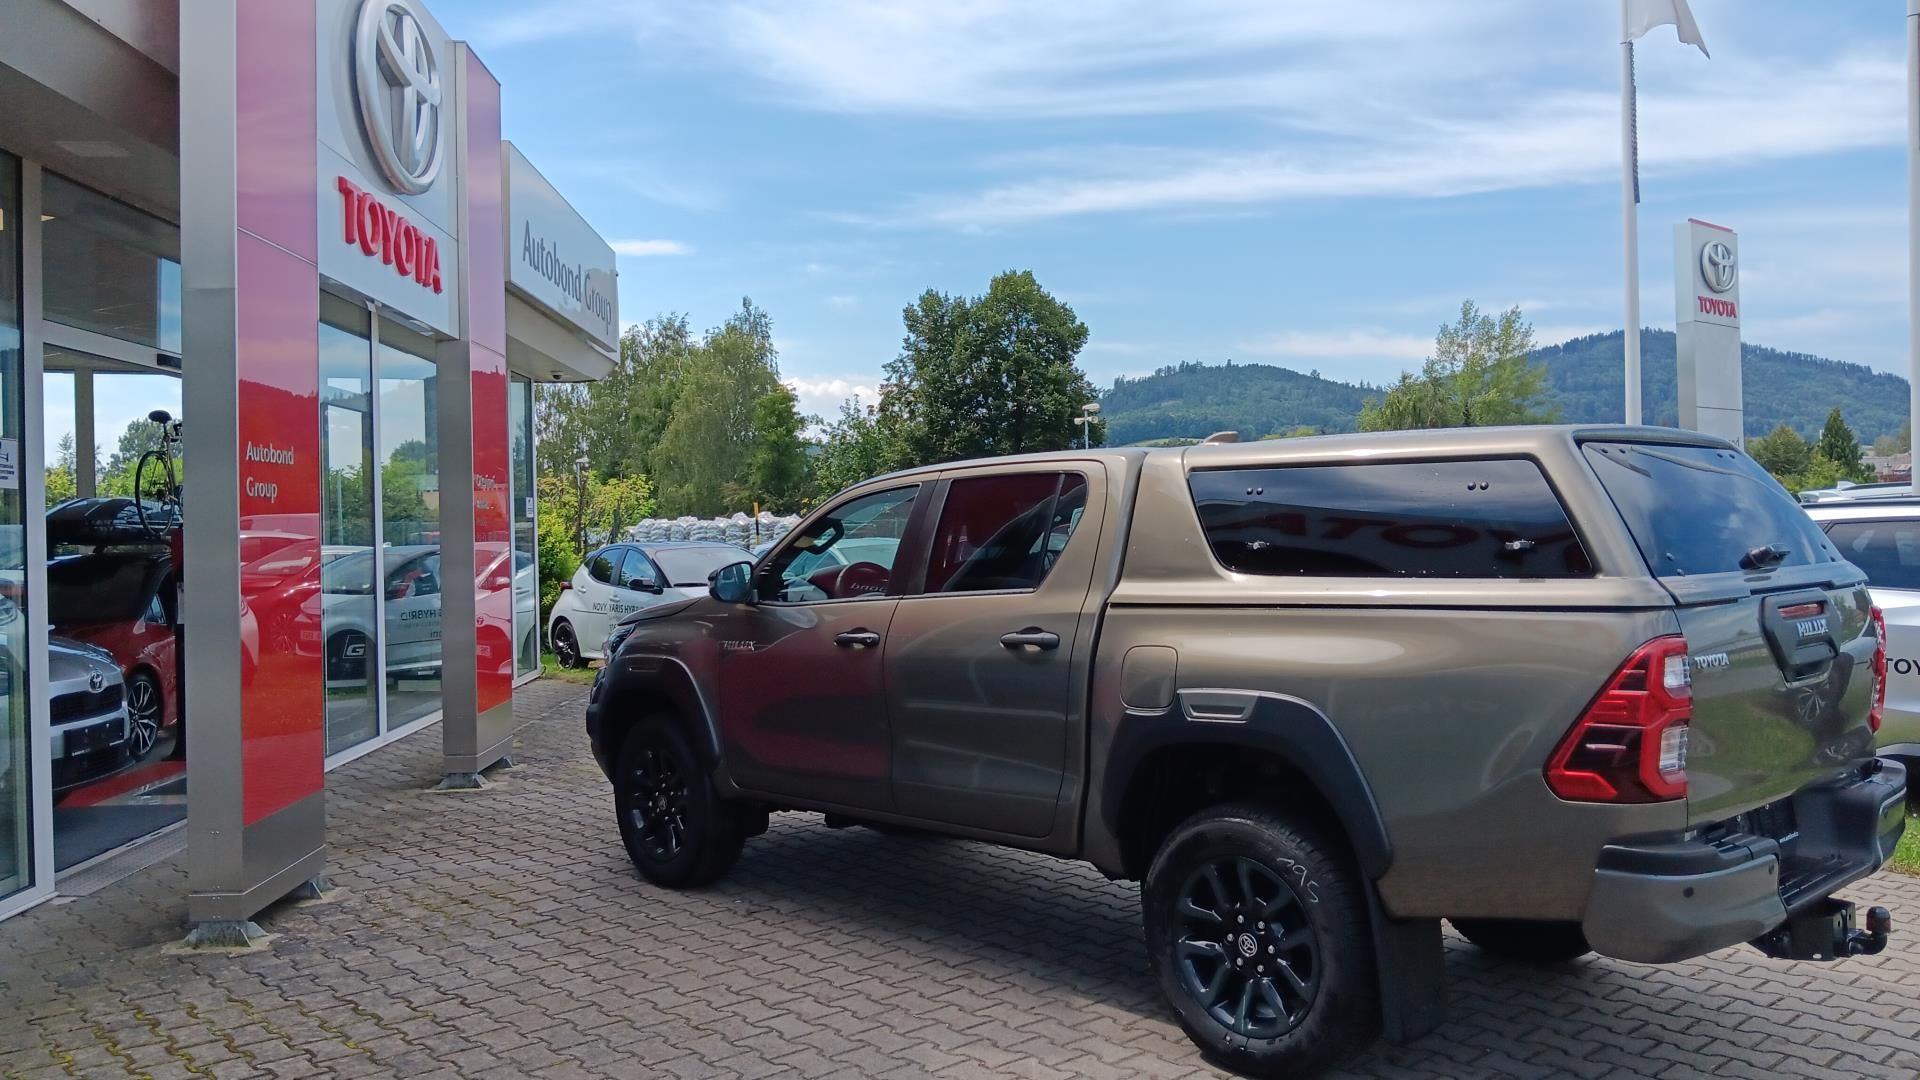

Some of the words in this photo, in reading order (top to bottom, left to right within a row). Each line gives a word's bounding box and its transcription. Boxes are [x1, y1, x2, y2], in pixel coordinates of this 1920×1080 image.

[338, 175, 443, 295] TOYOTA
[522, 220, 582, 302] Autobond
[584, 271, 612, 335] Group
[1697, 295, 1737, 318] TOYOTA
[246, 441, 294, 465] Autobond
[246, 476, 278, 503] Group
[608, 603, 623, 613] YARIS
[1694, 653, 1729, 669] TOYOTA
